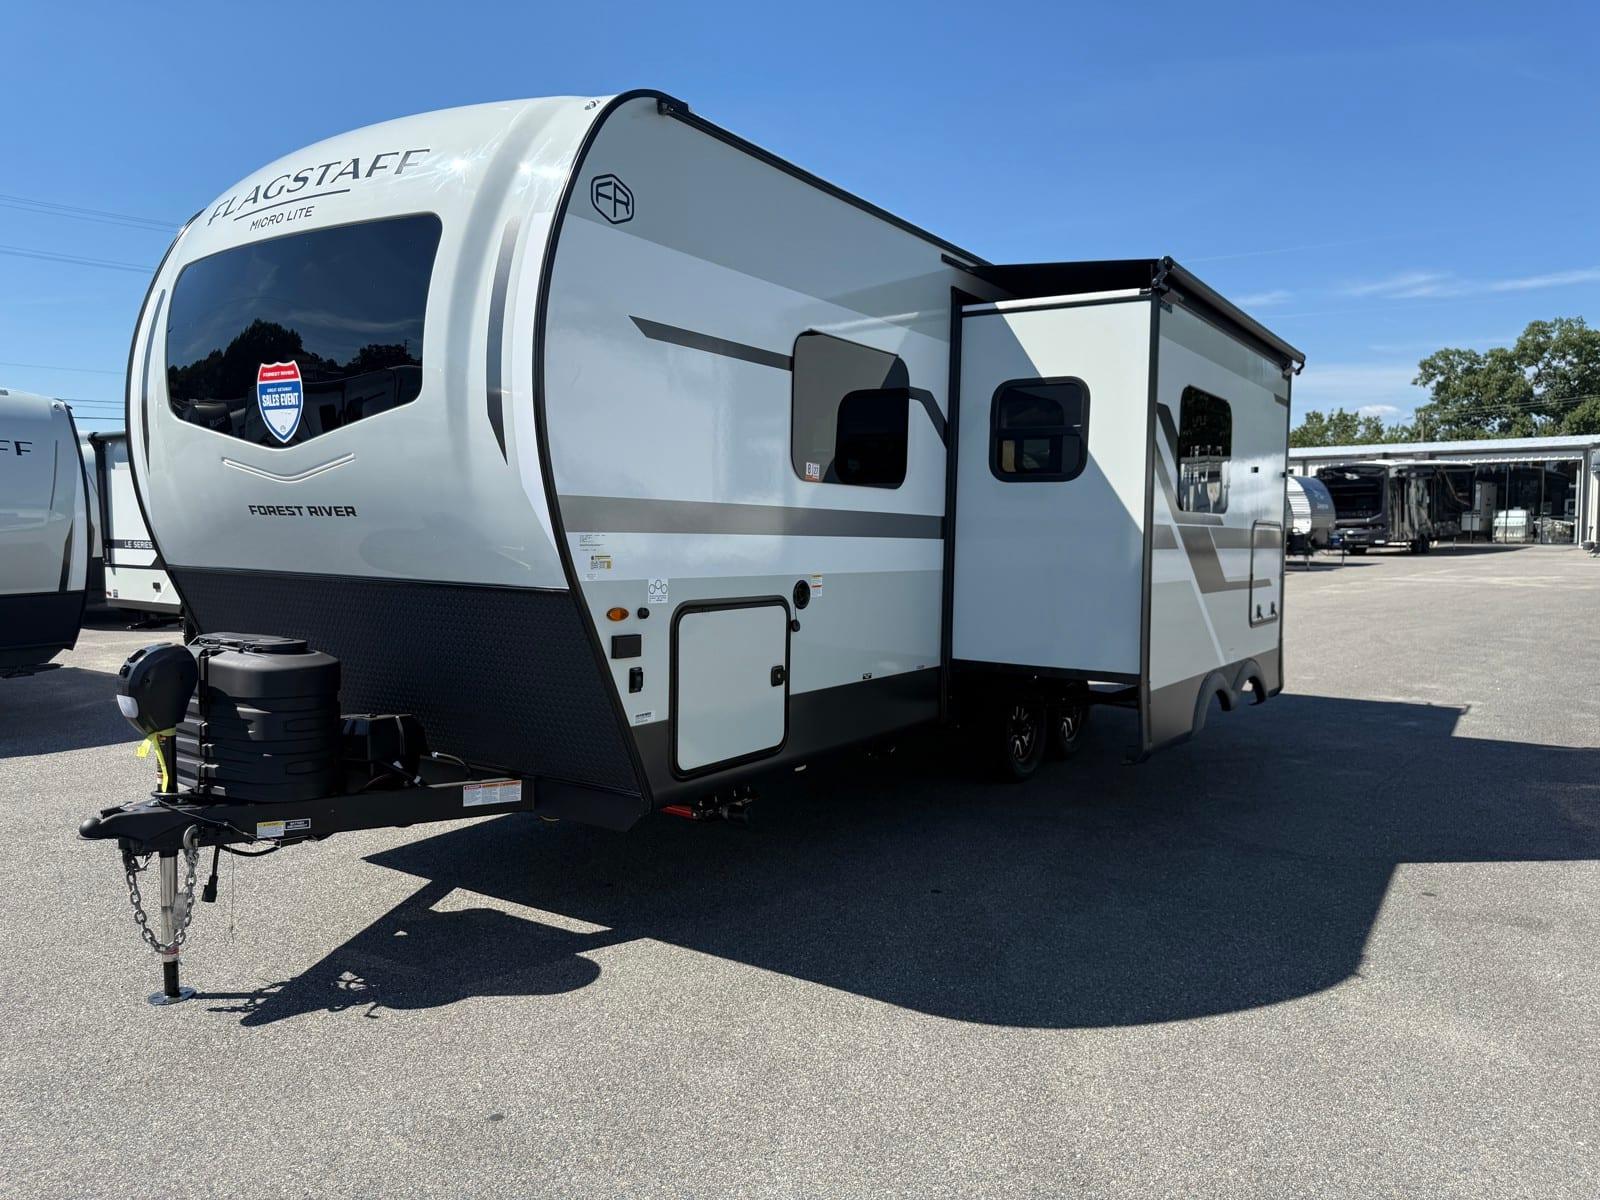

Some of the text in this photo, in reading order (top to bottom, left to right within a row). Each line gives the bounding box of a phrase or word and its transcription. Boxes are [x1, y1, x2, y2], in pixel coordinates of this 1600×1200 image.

[207, 149, 431, 226] FLAGSTAFF
[250, 206, 315, 231] MICRO LITE
[262, 393, 299, 407] SALES EVENT
[248, 504, 358, 517] FOREST RIVER
[133, 540, 153, 548] SERIES
